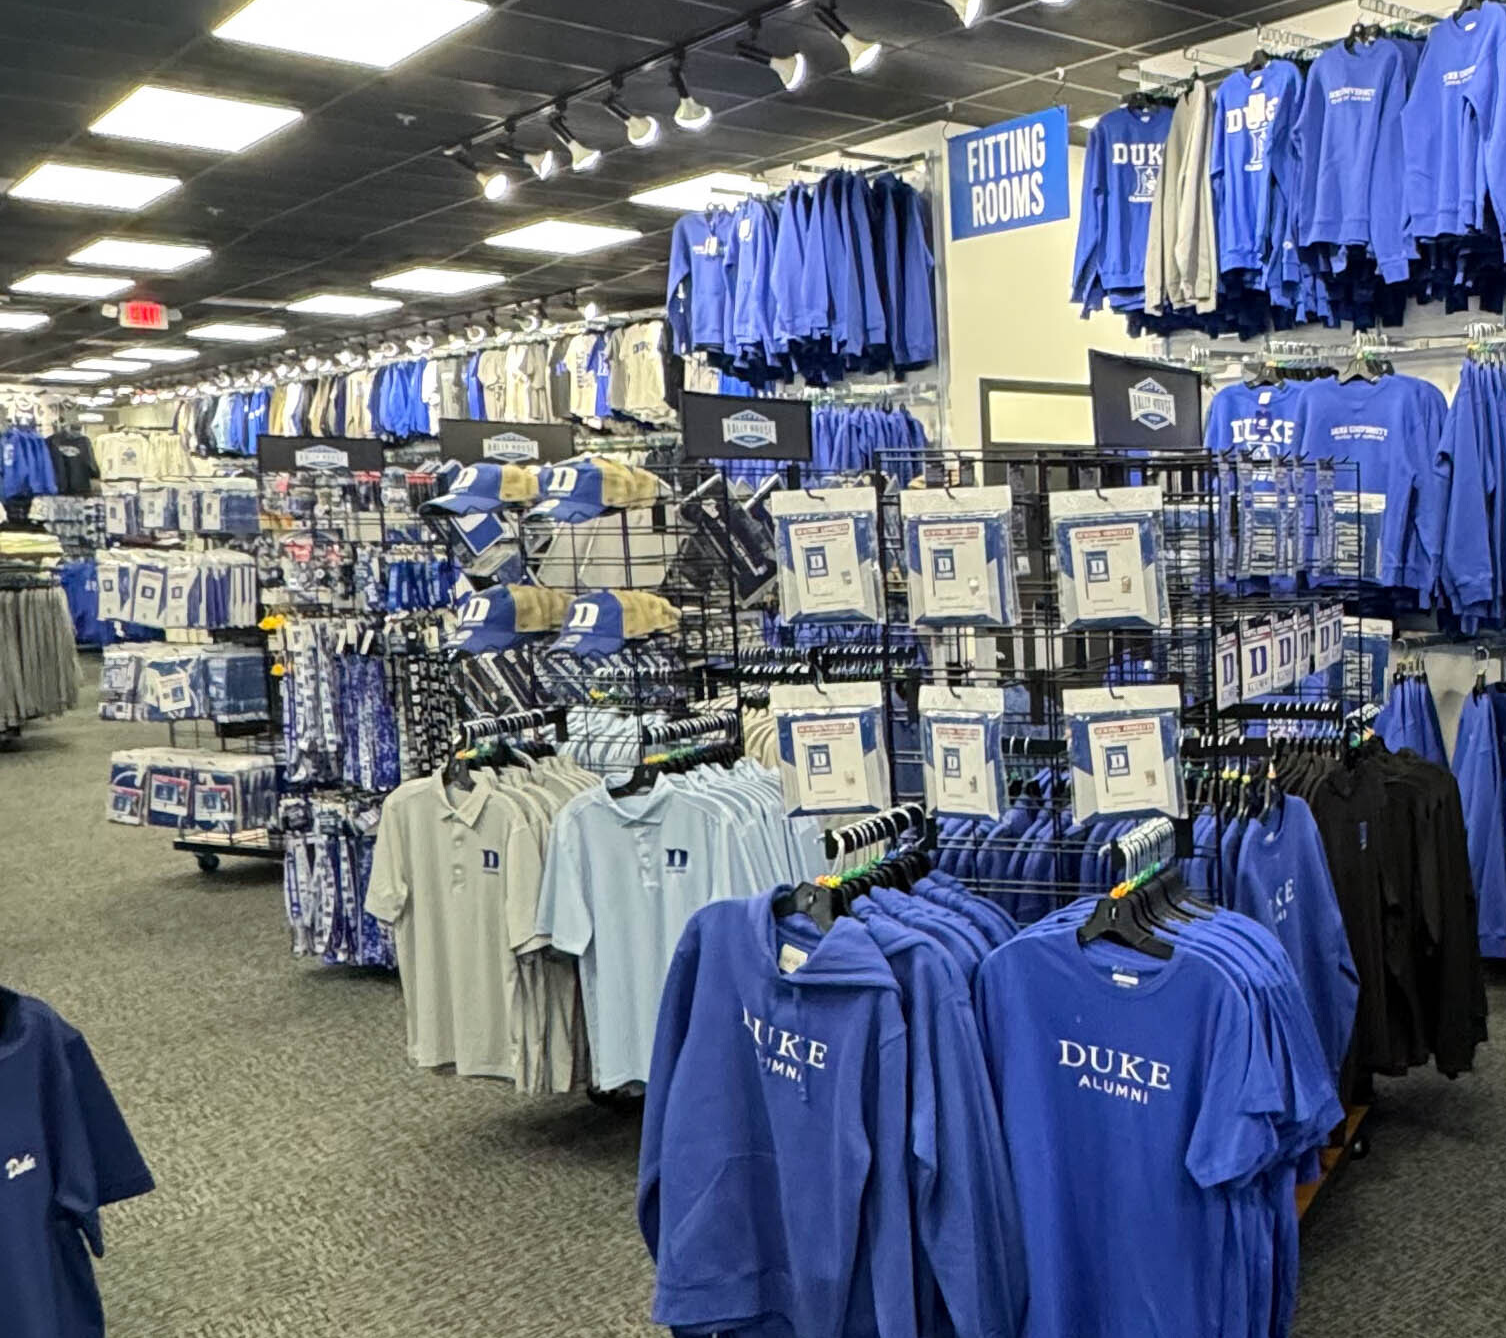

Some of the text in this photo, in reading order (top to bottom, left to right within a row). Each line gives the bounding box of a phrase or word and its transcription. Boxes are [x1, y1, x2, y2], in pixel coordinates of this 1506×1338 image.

[966, 122, 1046, 184] FITTING
[1112, 143, 1166, 166] DUK
[971, 171, 1045, 228] ROOMS
[1249, 645, 1268, 679] D
[1058, 1039, 1172, 1091] DUKE
[1078, 1074, 1149, 1105] ALUMNI
